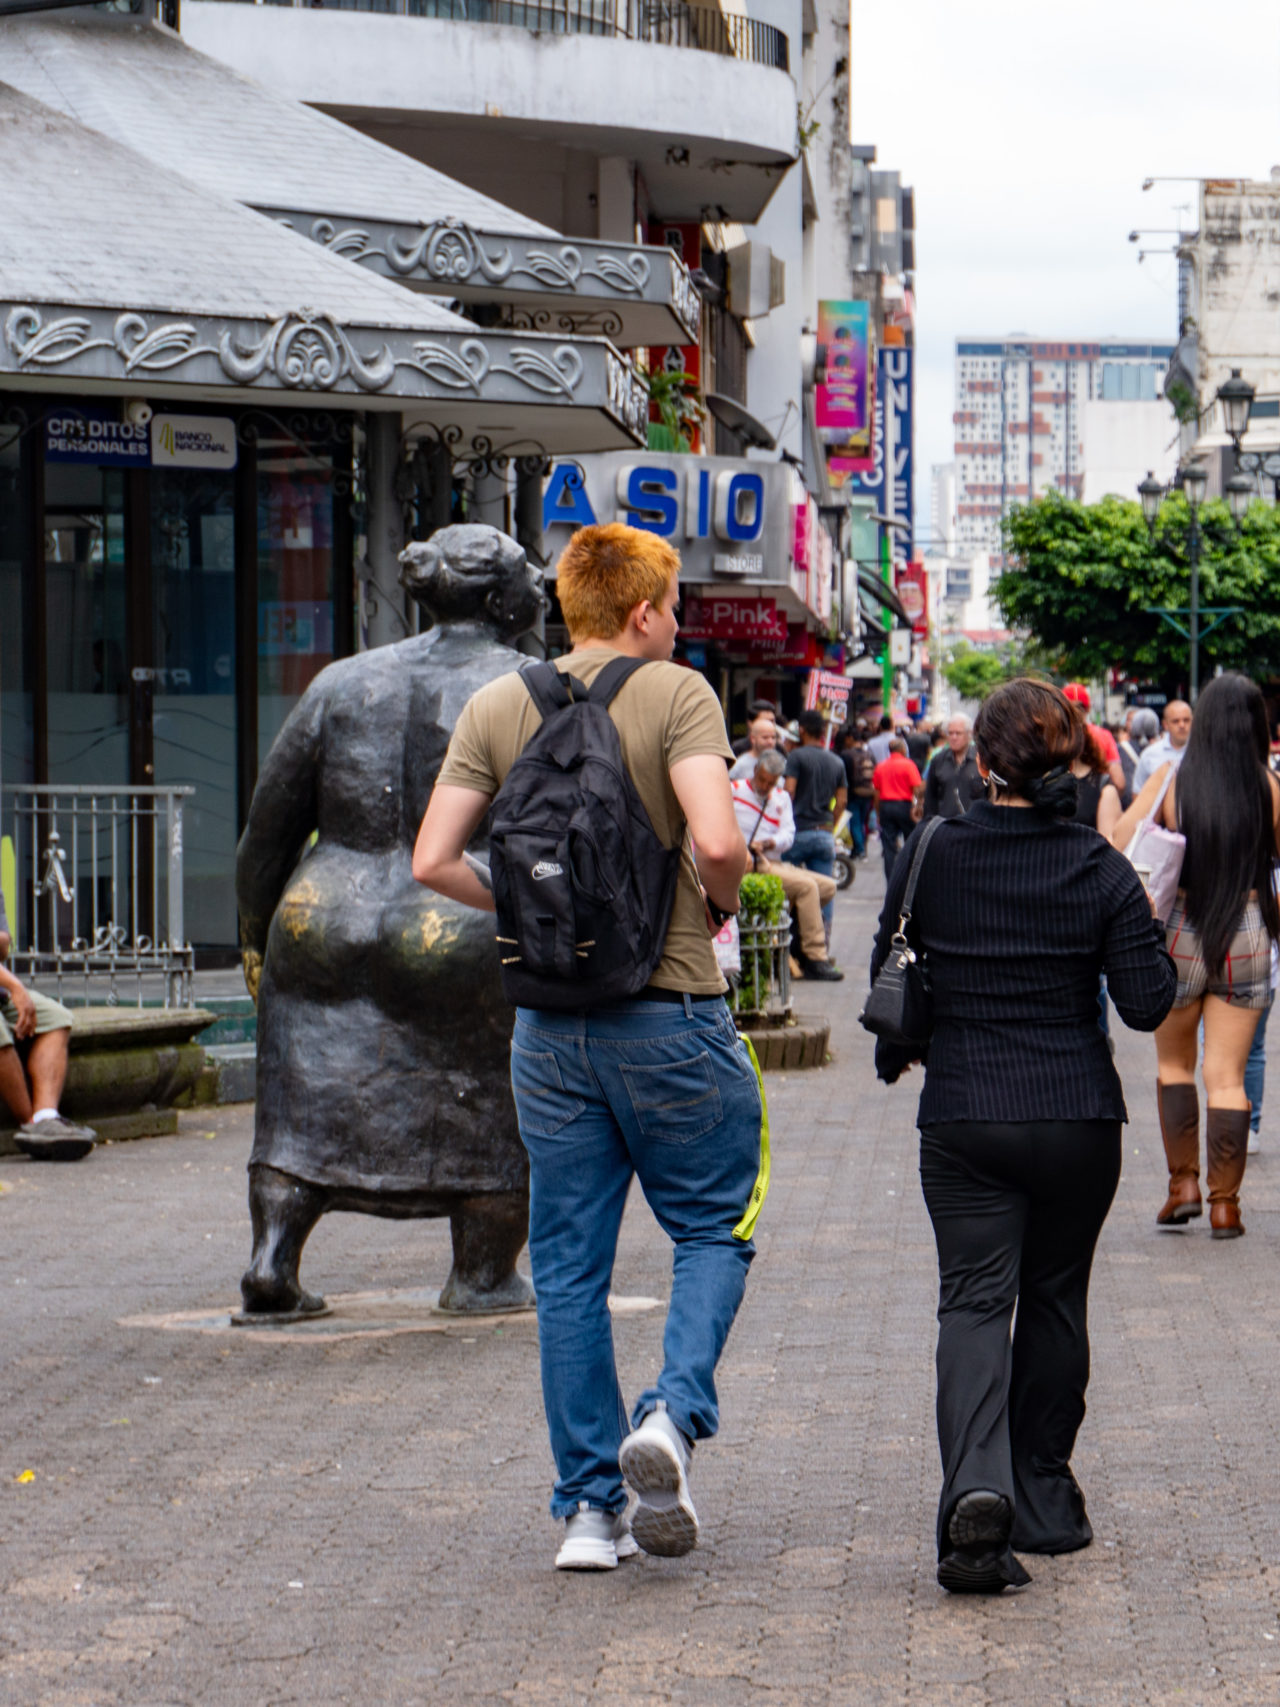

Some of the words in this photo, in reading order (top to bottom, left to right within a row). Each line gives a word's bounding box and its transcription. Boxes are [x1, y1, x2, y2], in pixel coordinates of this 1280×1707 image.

[175, 430, 212, 444] BANCO
[175, 440, 229, 454] NACIONAL
[713, 602, 772, 624] Pink
